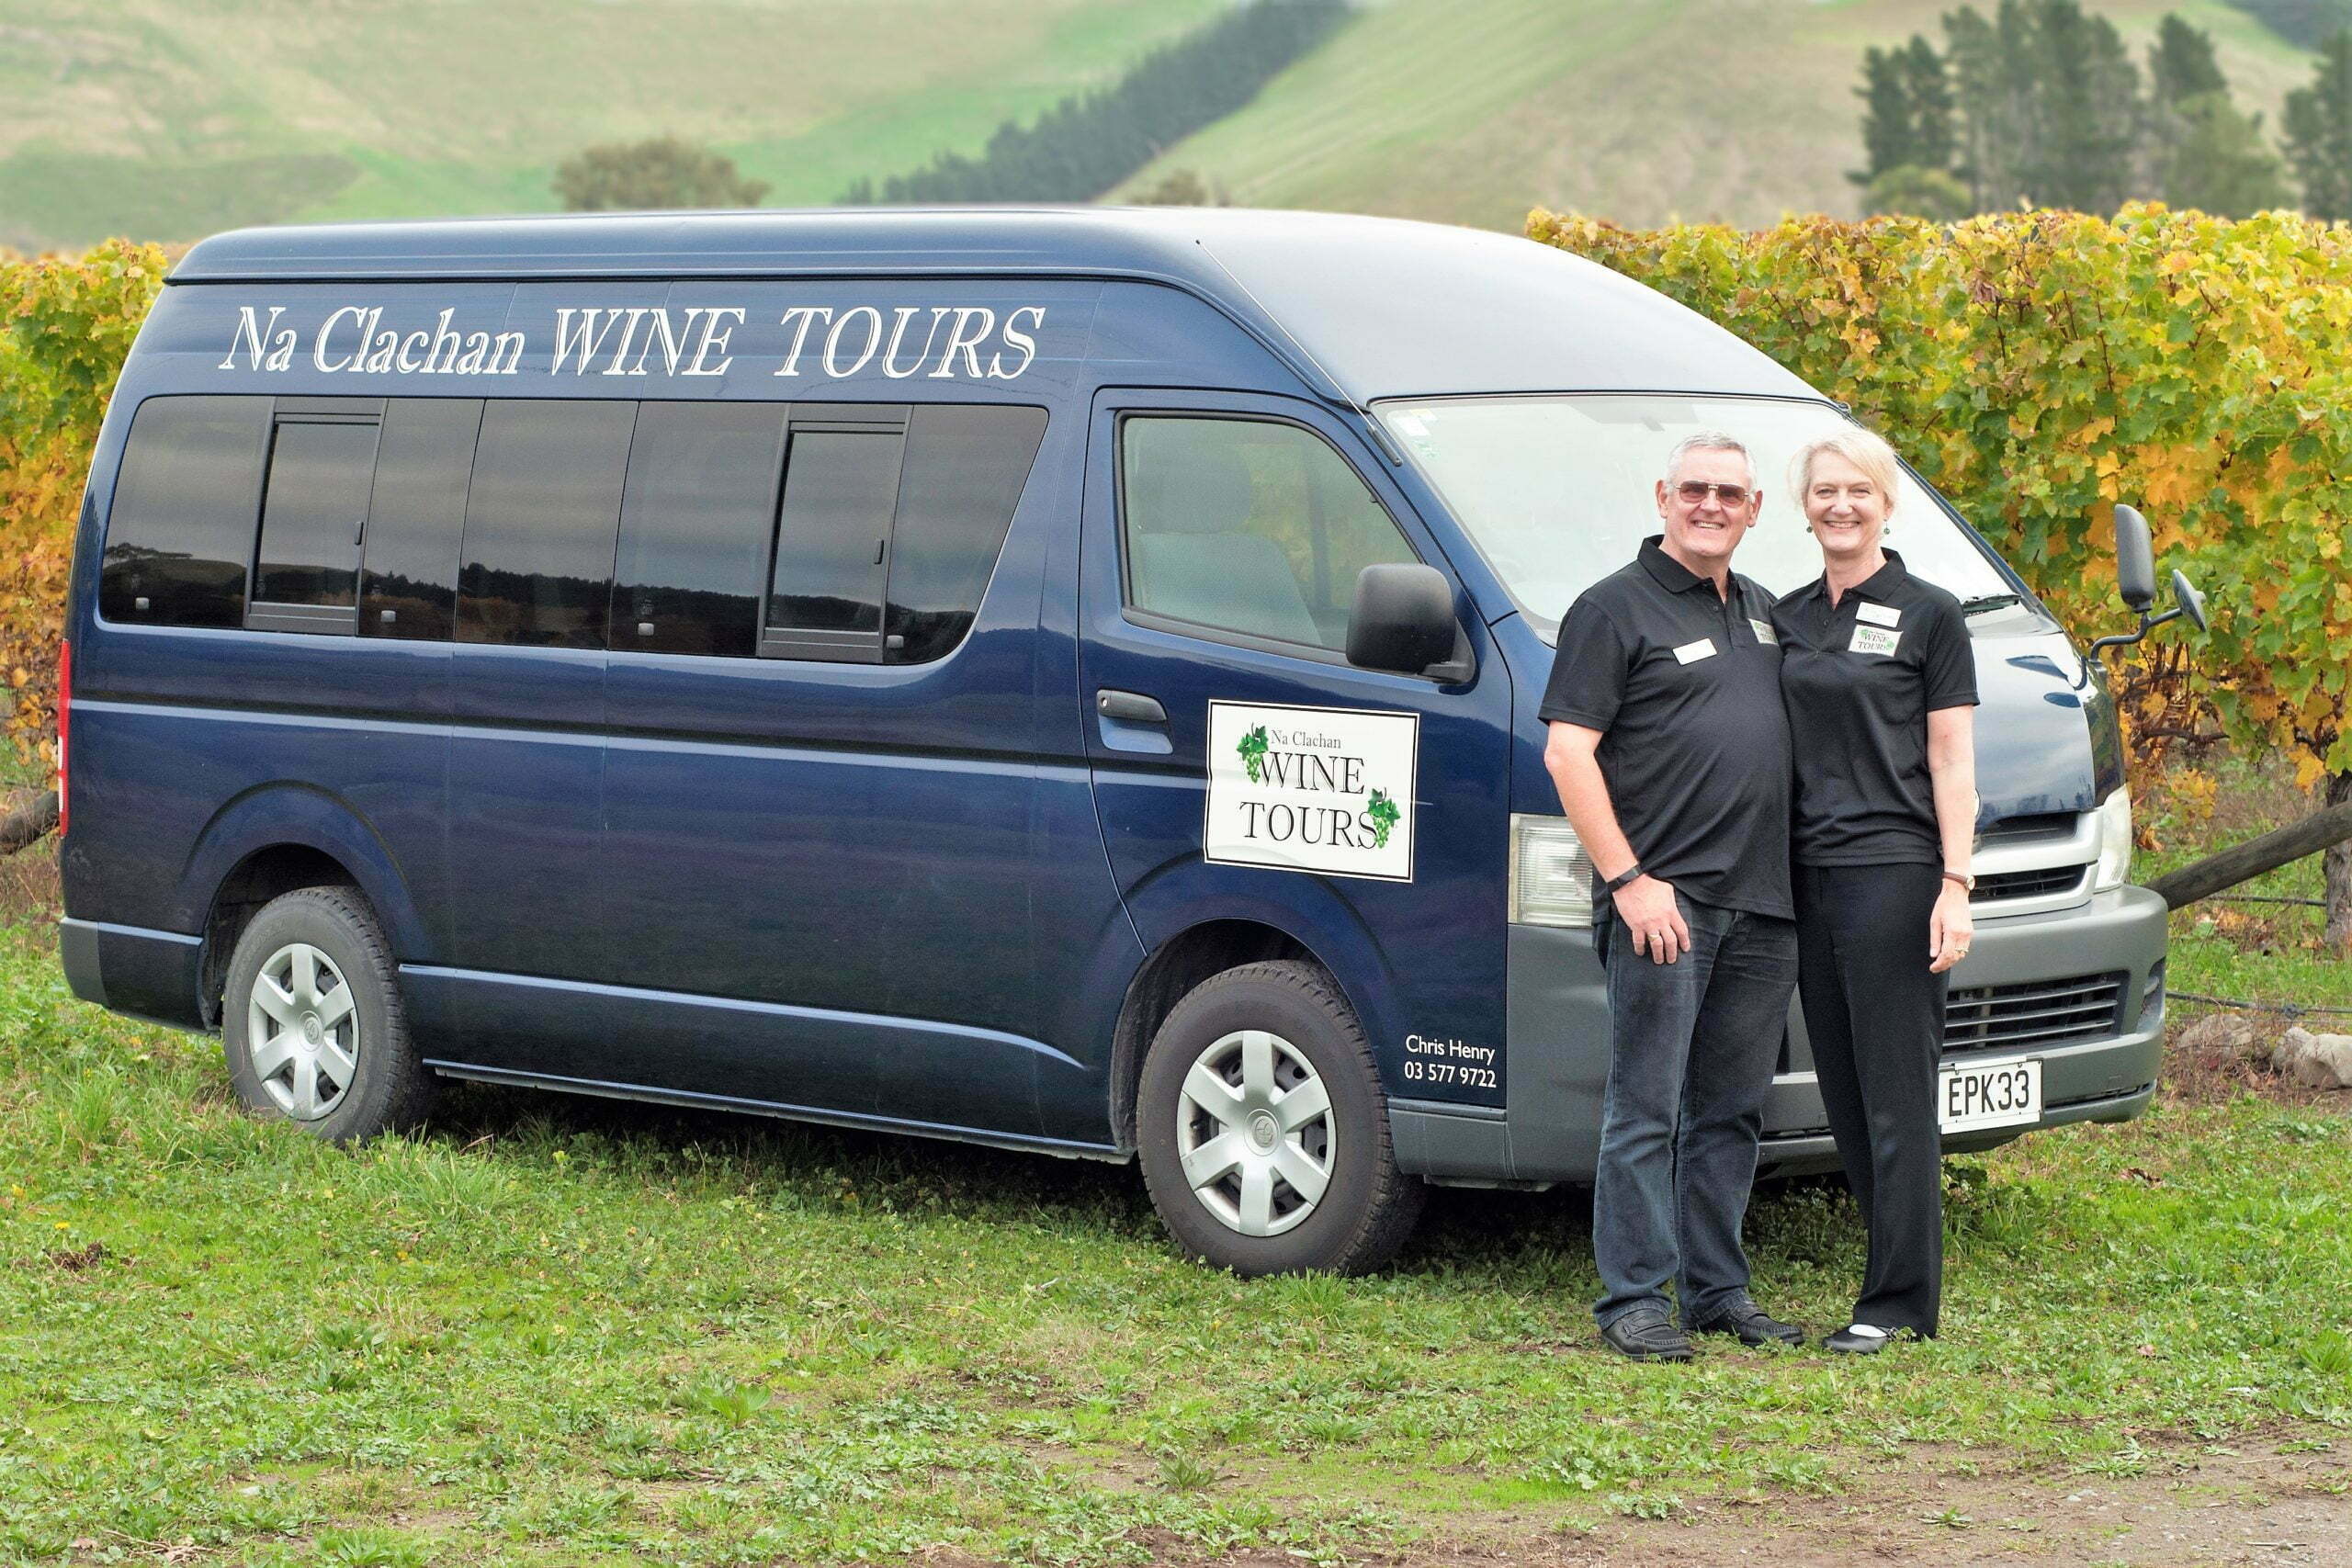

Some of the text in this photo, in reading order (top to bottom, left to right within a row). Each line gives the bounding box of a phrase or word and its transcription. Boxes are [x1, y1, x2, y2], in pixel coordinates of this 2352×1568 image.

[218, 305, 1046, 380] Na Clachan WINE TOURS
[1271, 729, 1341, 750] Na Clachan
[1261, 751, 1365, 795] WINE
[1239, 801, 1377, 850] TOURS
[1405, 1034, 1496, 1066] Chris Henry
[1404, 1061, 1498, 1089] 03 577 9722
[1949, 1069, 2030, 1118] EPK33
